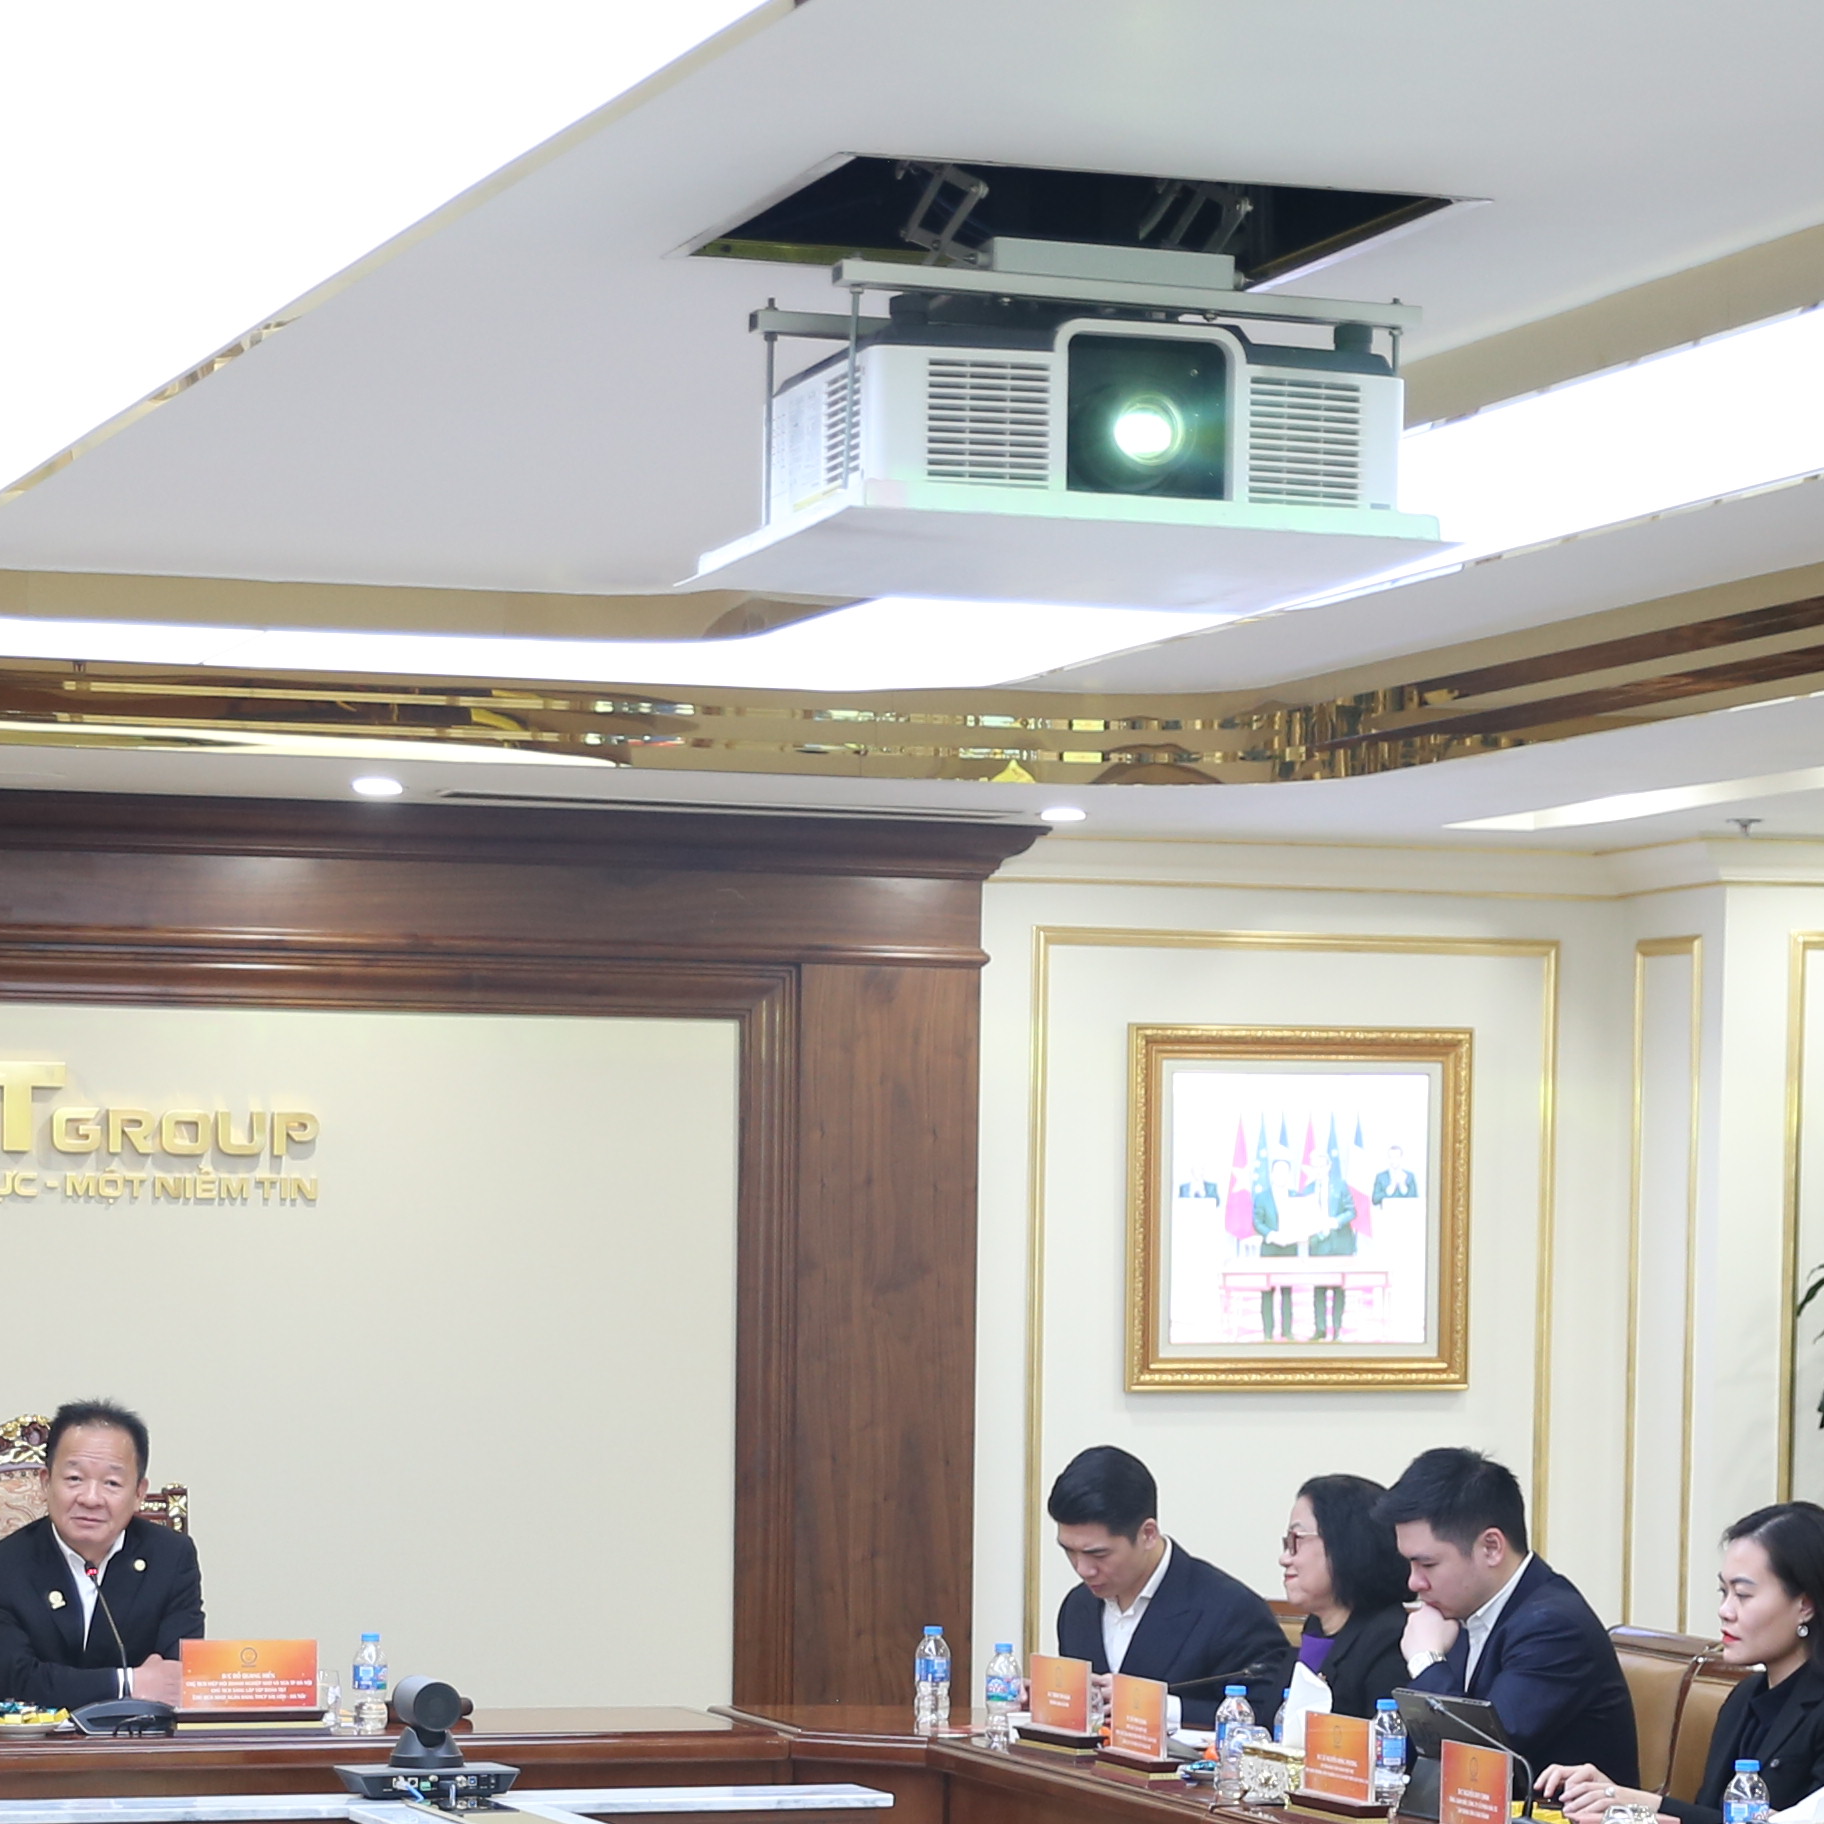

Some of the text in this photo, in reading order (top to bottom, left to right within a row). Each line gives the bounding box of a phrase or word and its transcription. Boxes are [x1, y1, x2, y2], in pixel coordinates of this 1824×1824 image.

[65, 1167, 149, 1205] MỘT
[153, 1163, 250, 1201] NIỀM
[256, 1172, 319, 1202] TIN
